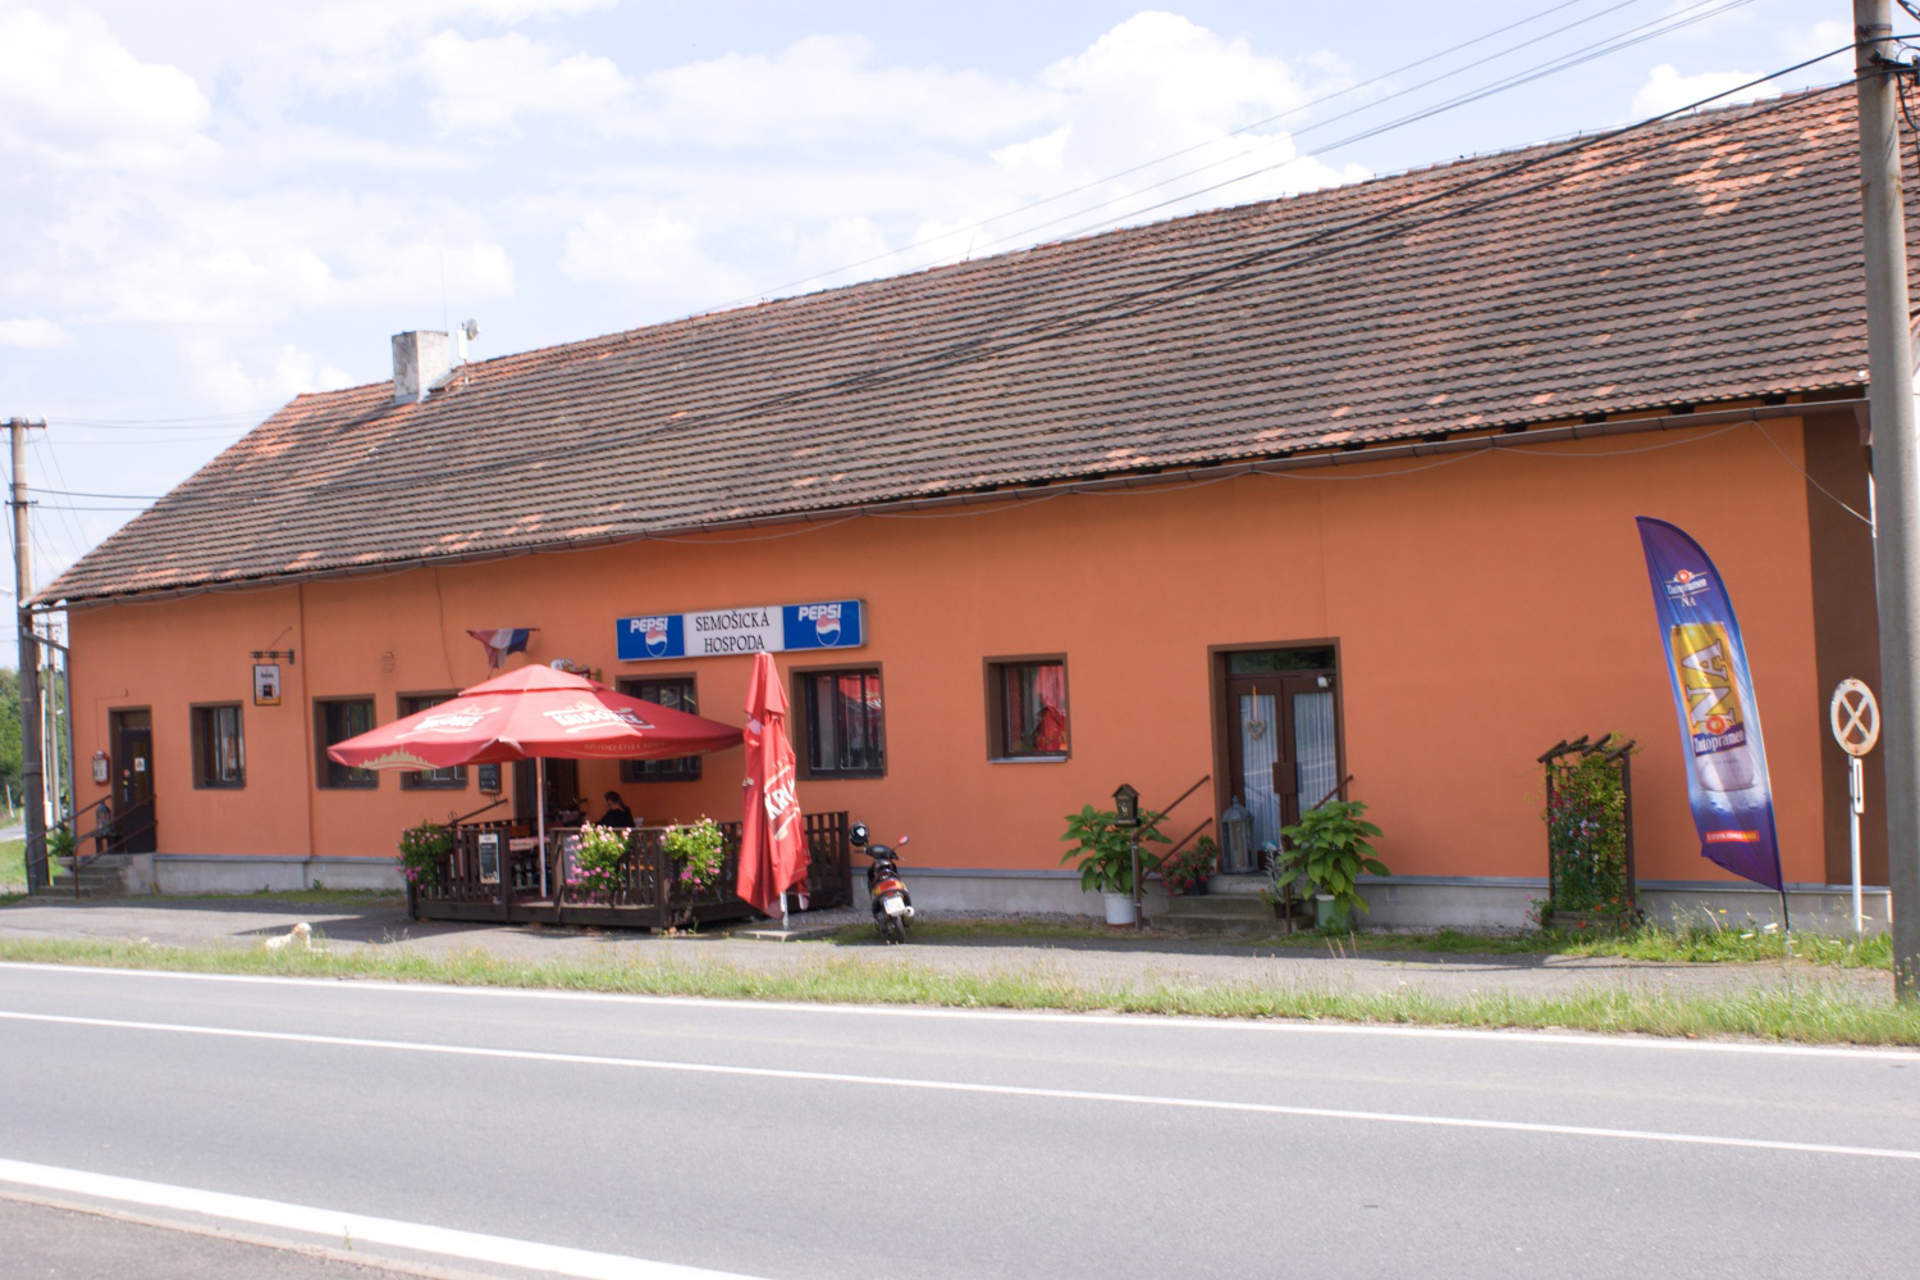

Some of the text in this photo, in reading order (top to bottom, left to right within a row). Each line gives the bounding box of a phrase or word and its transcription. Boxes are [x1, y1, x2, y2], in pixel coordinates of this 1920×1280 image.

[695, 607, 770, 632] SEMOŠICKÁ
[798, 603, 842, 622] PEPSI
[630, 617, 669, 634] PEPSI
[704, 634, 765, 653] HOSPODA
